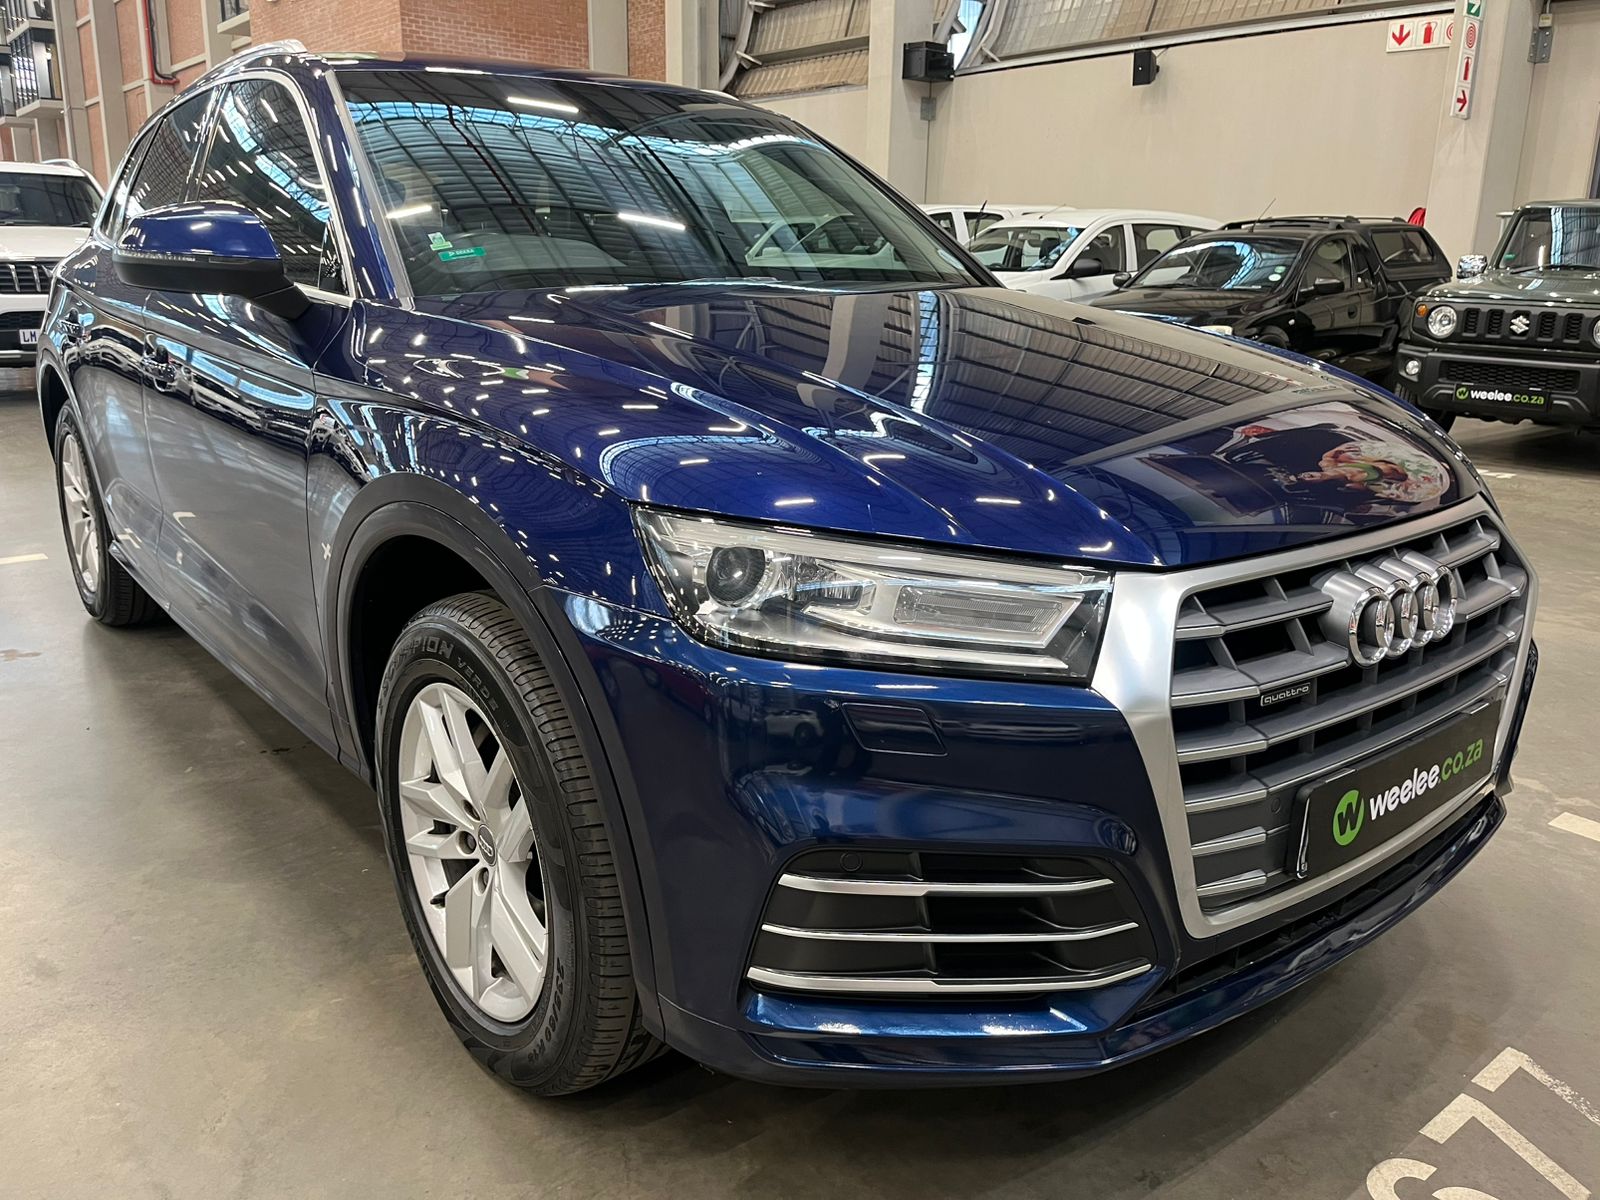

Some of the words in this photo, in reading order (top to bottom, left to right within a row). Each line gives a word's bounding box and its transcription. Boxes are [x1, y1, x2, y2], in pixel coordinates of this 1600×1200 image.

[1470, 389, 1545, 405] weelee.co.za
[457, 656, 499, 712] VERDE
[1264, 685, 1309, 704] quattro
[1369, 738, 1484, 821] weelee.co.za
